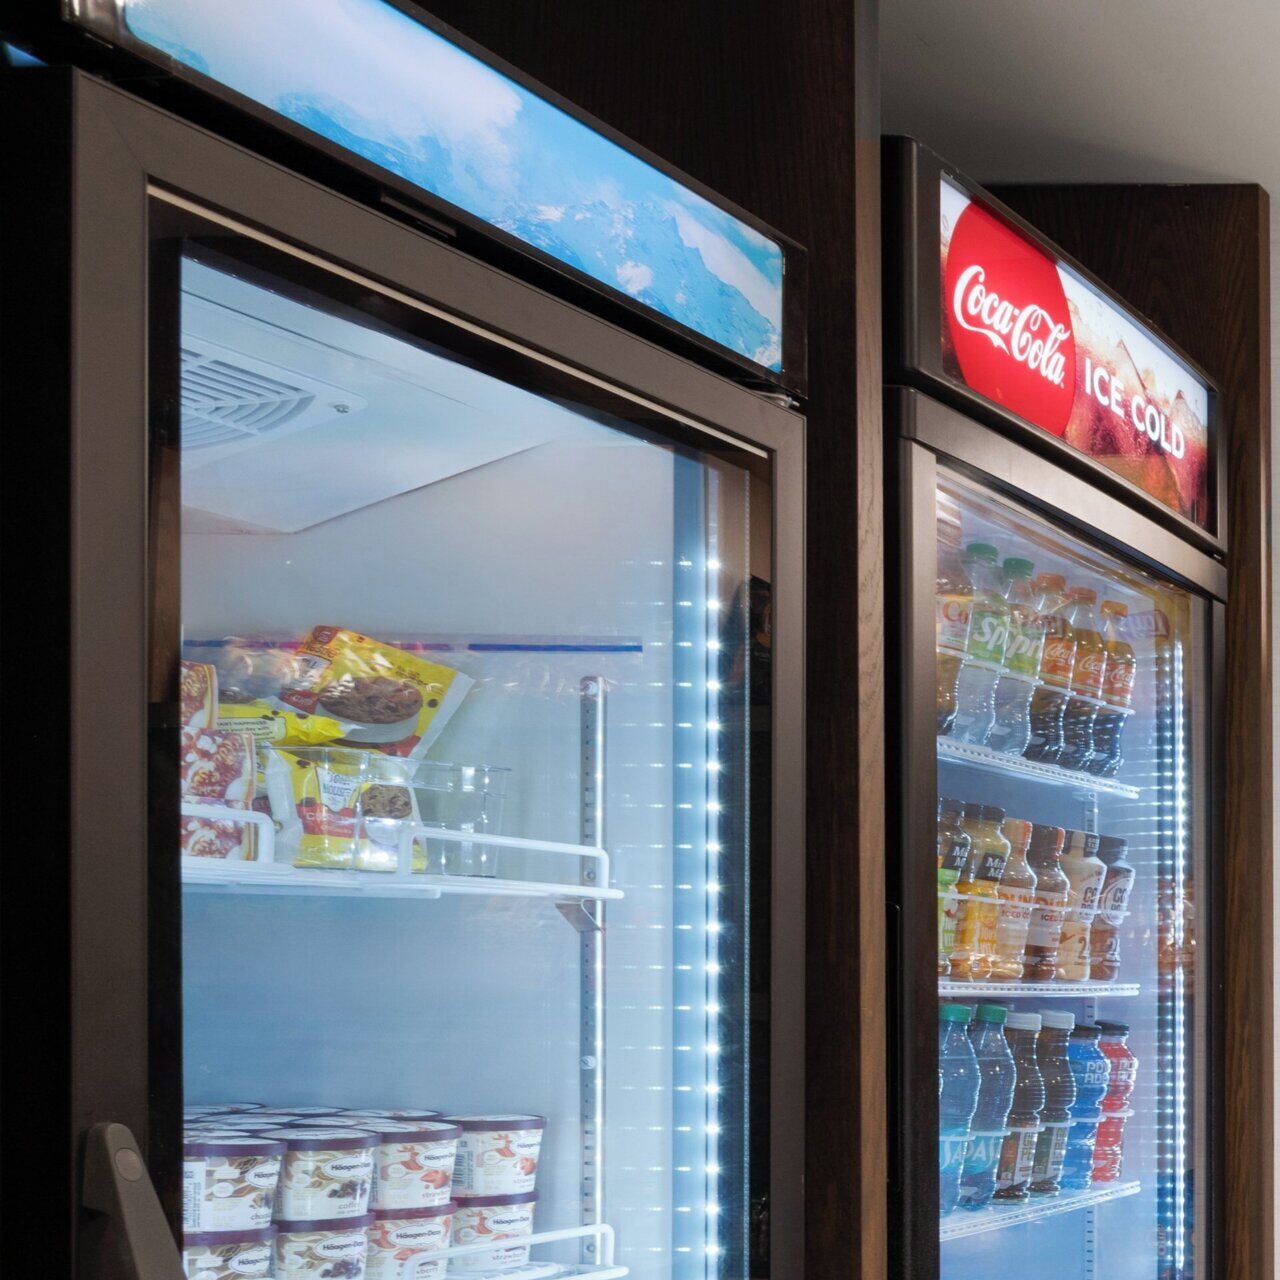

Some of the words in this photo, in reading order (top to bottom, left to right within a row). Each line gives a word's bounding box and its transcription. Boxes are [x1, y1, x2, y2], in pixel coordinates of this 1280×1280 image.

[953, 265, 1071, 388] Coca-Cola
[1085, 357, 1126, 419] ICE
[1131, 394, 1185, 460] COLD
[396, 1228, 442, 1241] Häagen-Daz
